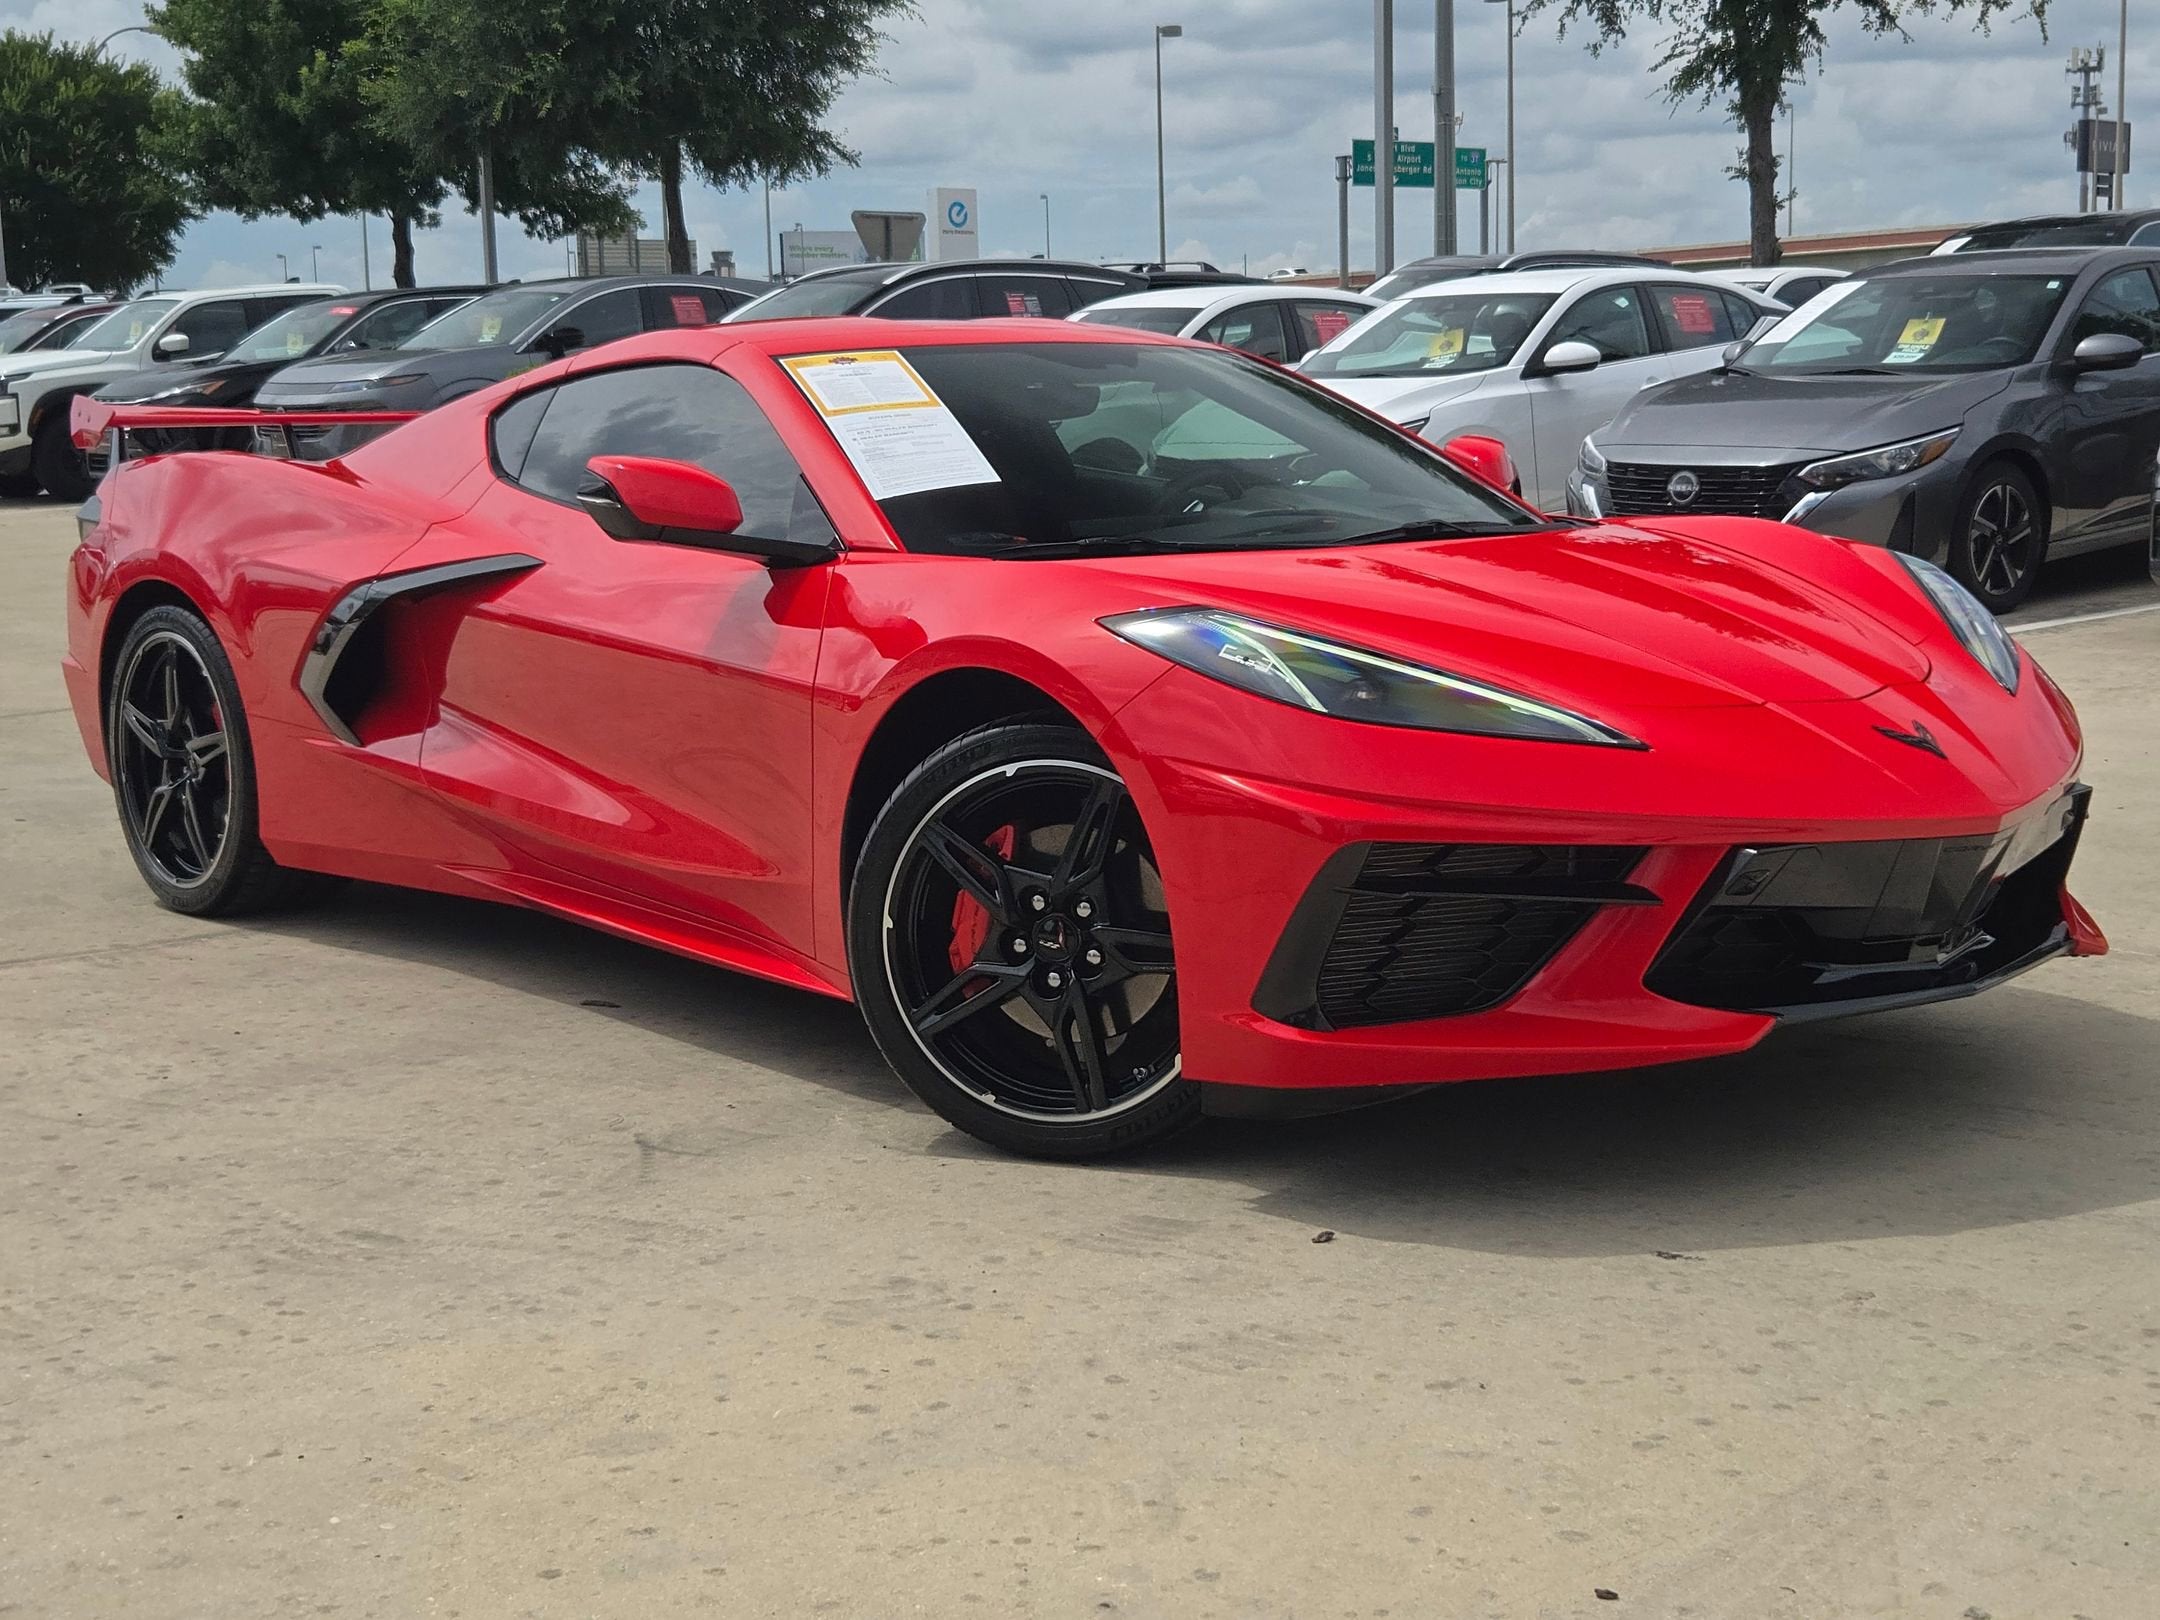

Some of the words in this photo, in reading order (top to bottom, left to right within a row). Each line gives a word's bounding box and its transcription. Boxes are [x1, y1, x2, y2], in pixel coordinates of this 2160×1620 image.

[1400, 144, 1416, 153] Blvd
[1397, 154, 1421, 165] Airport
[1393, 165, 1420, 175] sberger
[1422, 165, 1433, 174] Rd
[1456, 168, 1482, 176] Antonio
[1469, 177, 1483, 187] City
